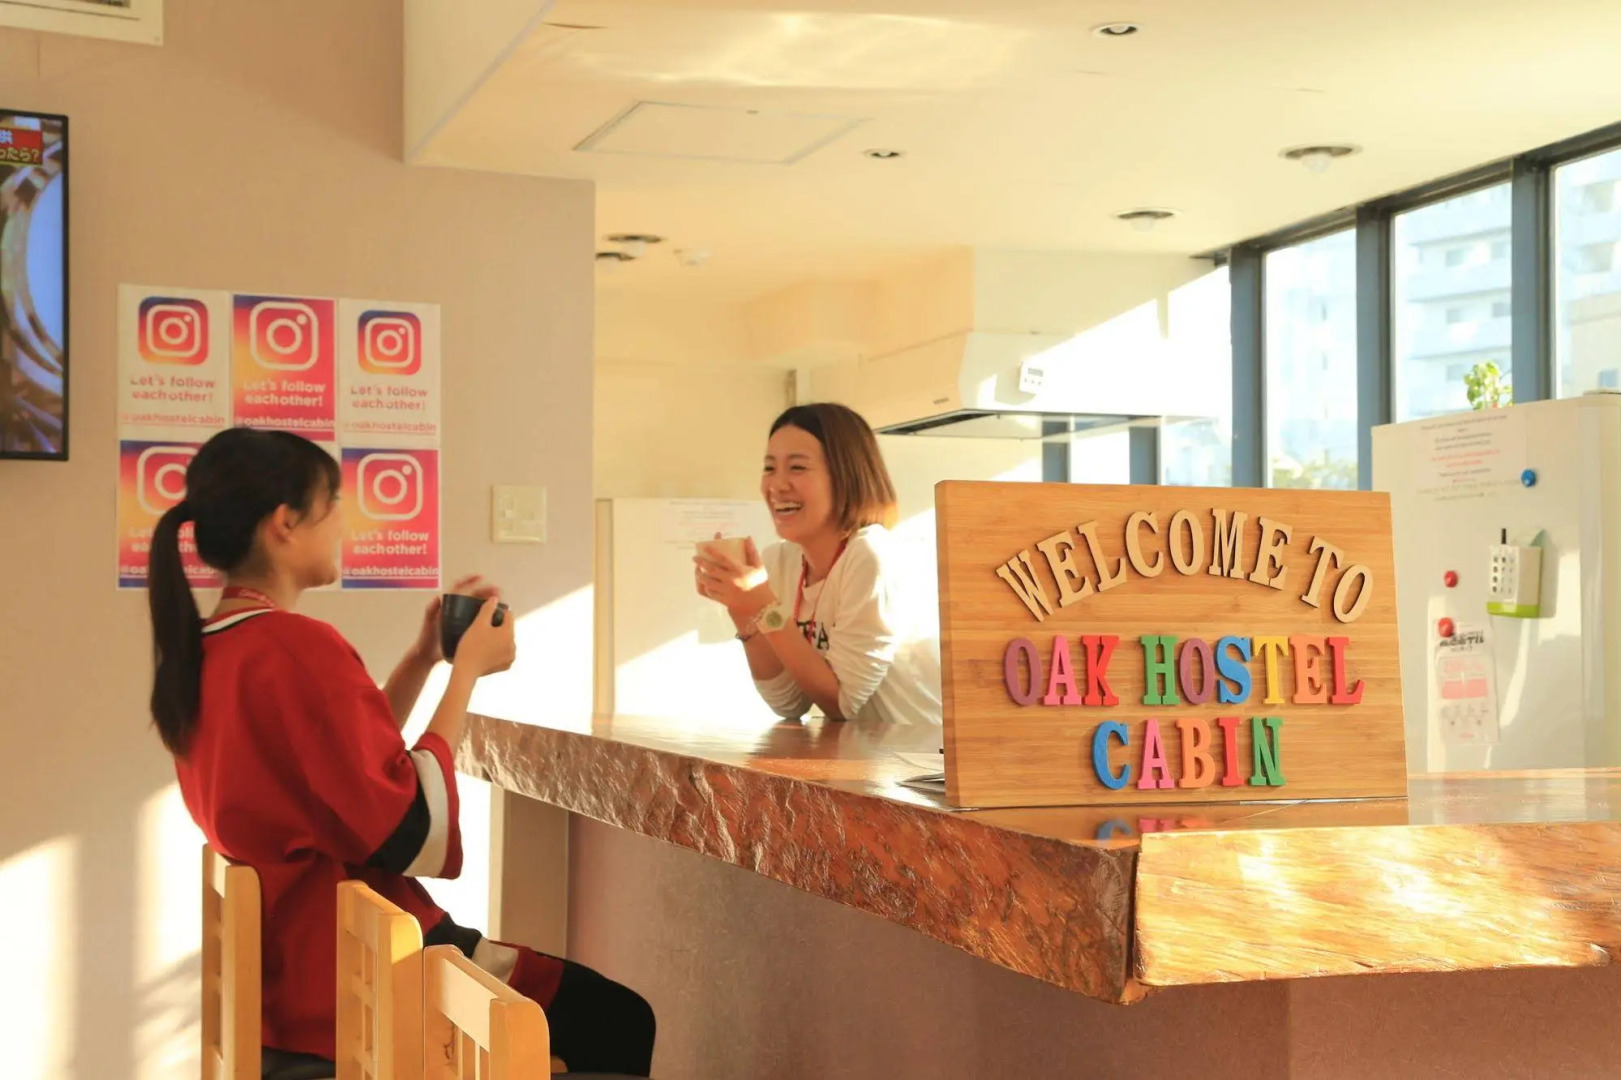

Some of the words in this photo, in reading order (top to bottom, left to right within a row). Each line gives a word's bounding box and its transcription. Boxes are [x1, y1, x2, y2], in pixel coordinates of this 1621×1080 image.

[130, 374, 165, 386] Let's
[170, 374, 216, 389] follow
[243, 379, 277, 391] Let's
[281, 379, 326, 393] follow
[350, 384, 382, 396] Let's
[387, 385, 429, 397] follow
[351, 529, 382, 541] Let's
[387, 530, 429, 541] follow
[995, 507, 1293, 622] WELCOME
[1299, 535, 1374, 623] TO
[1003, 634, 1120, 706] OAK
[1138, 634, 1365, 705] HOSTEL
[1091, 715, 1287, 790] CABIN
